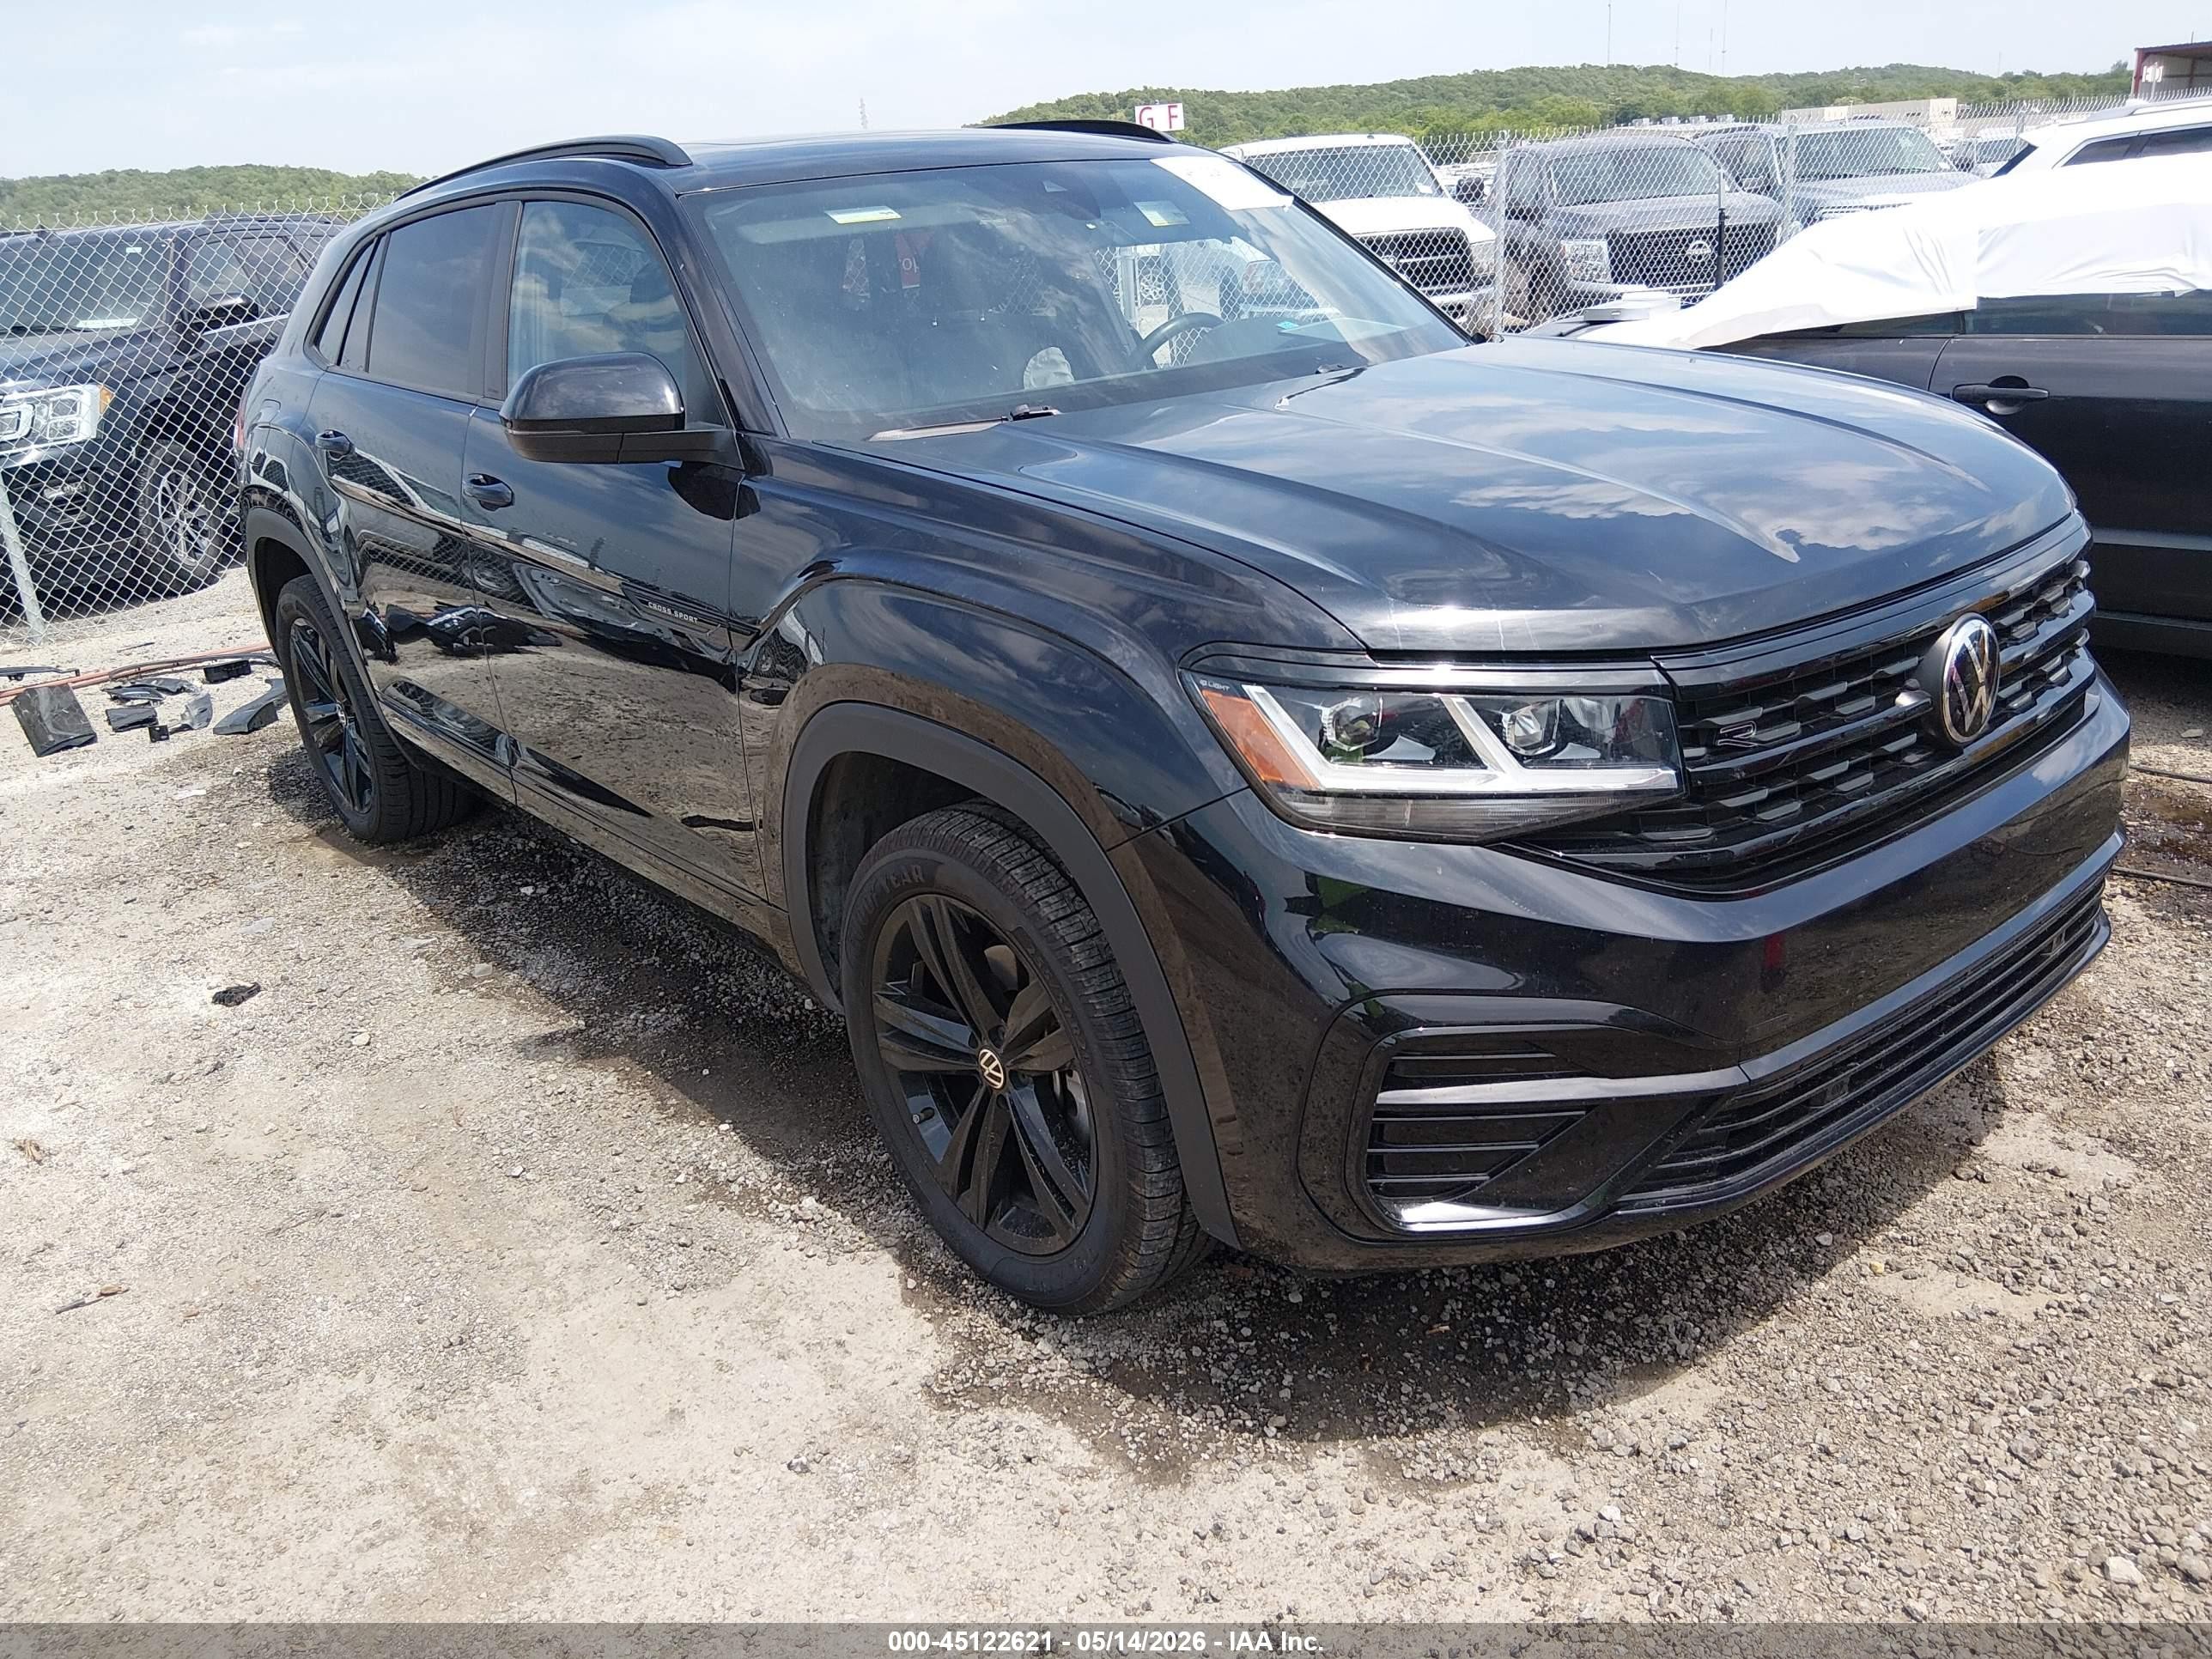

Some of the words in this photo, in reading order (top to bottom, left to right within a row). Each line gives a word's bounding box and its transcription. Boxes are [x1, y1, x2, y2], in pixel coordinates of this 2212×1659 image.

[1139, 106, 1154, 128] G
[1168, 105, 1178, 130] F
[648, 602, 672, 615] CROSS
[674, 611, 698, 624] SPORT
